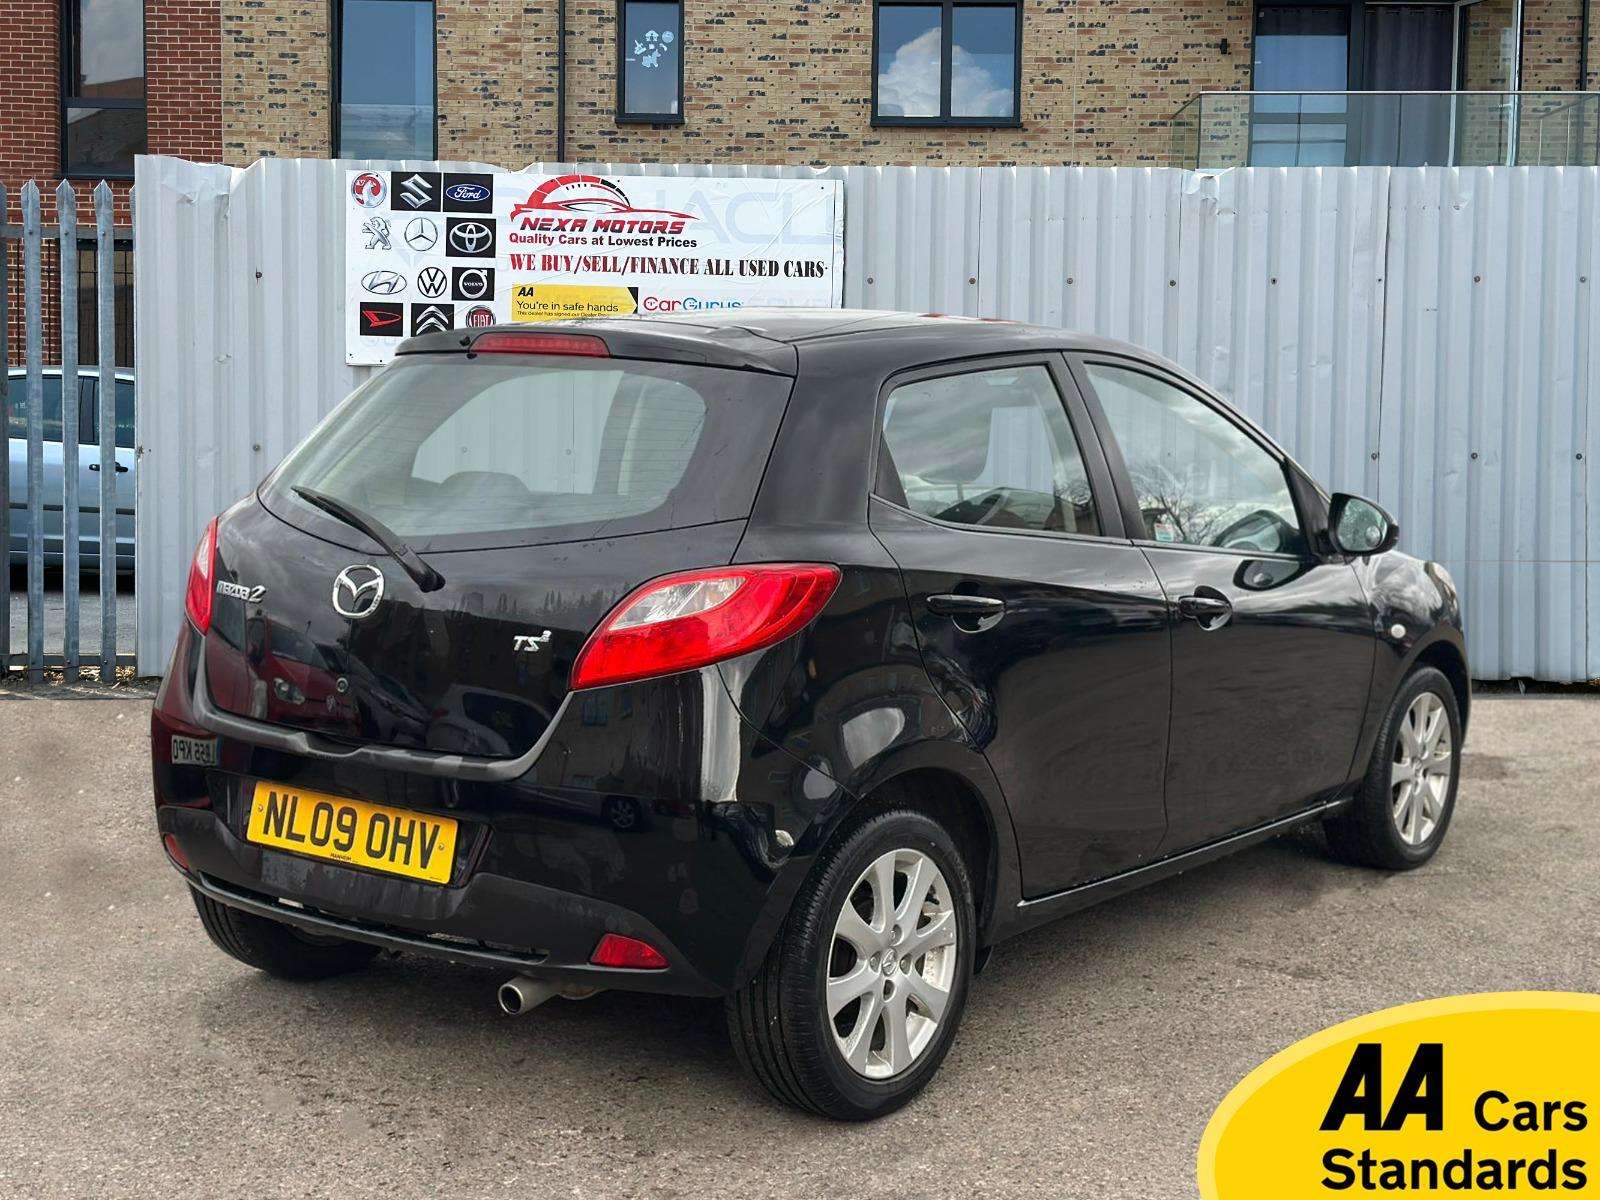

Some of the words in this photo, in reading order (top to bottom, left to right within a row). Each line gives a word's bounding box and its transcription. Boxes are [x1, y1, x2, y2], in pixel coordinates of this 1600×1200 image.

[454, 187, 482, 199] Ford
[520, 217, 588, 232] NEXA
[592, 218, 686, 235] MOTORS
[509, 233, 555, 246] Quality
[558, 234, 588, 245] Cars
[591, 236, 605, 246] at
[608, 236, 654, 247] Lowest
[657, 237, 698, 248] Prices
[509, 253, 536, 271] WE
[541, 254, 699, 276] BUY/SELL/FINANCE
[703, 258, 734, 276] ALL
[739, 259, 780, 277] USED
[783, 260, 825, 278] CARS
[517, 286, 534, 297] AA
[516, 300, 549, 310] You're
[551, 302, 560, 310] in
[562, 302, 585, 311] safe
[587, 303, 619, 312] hands
[473, 314, 491, 327] FIAT
[263, 791, 358, 852] NL09
[365, 812, 440, 870] OHV
